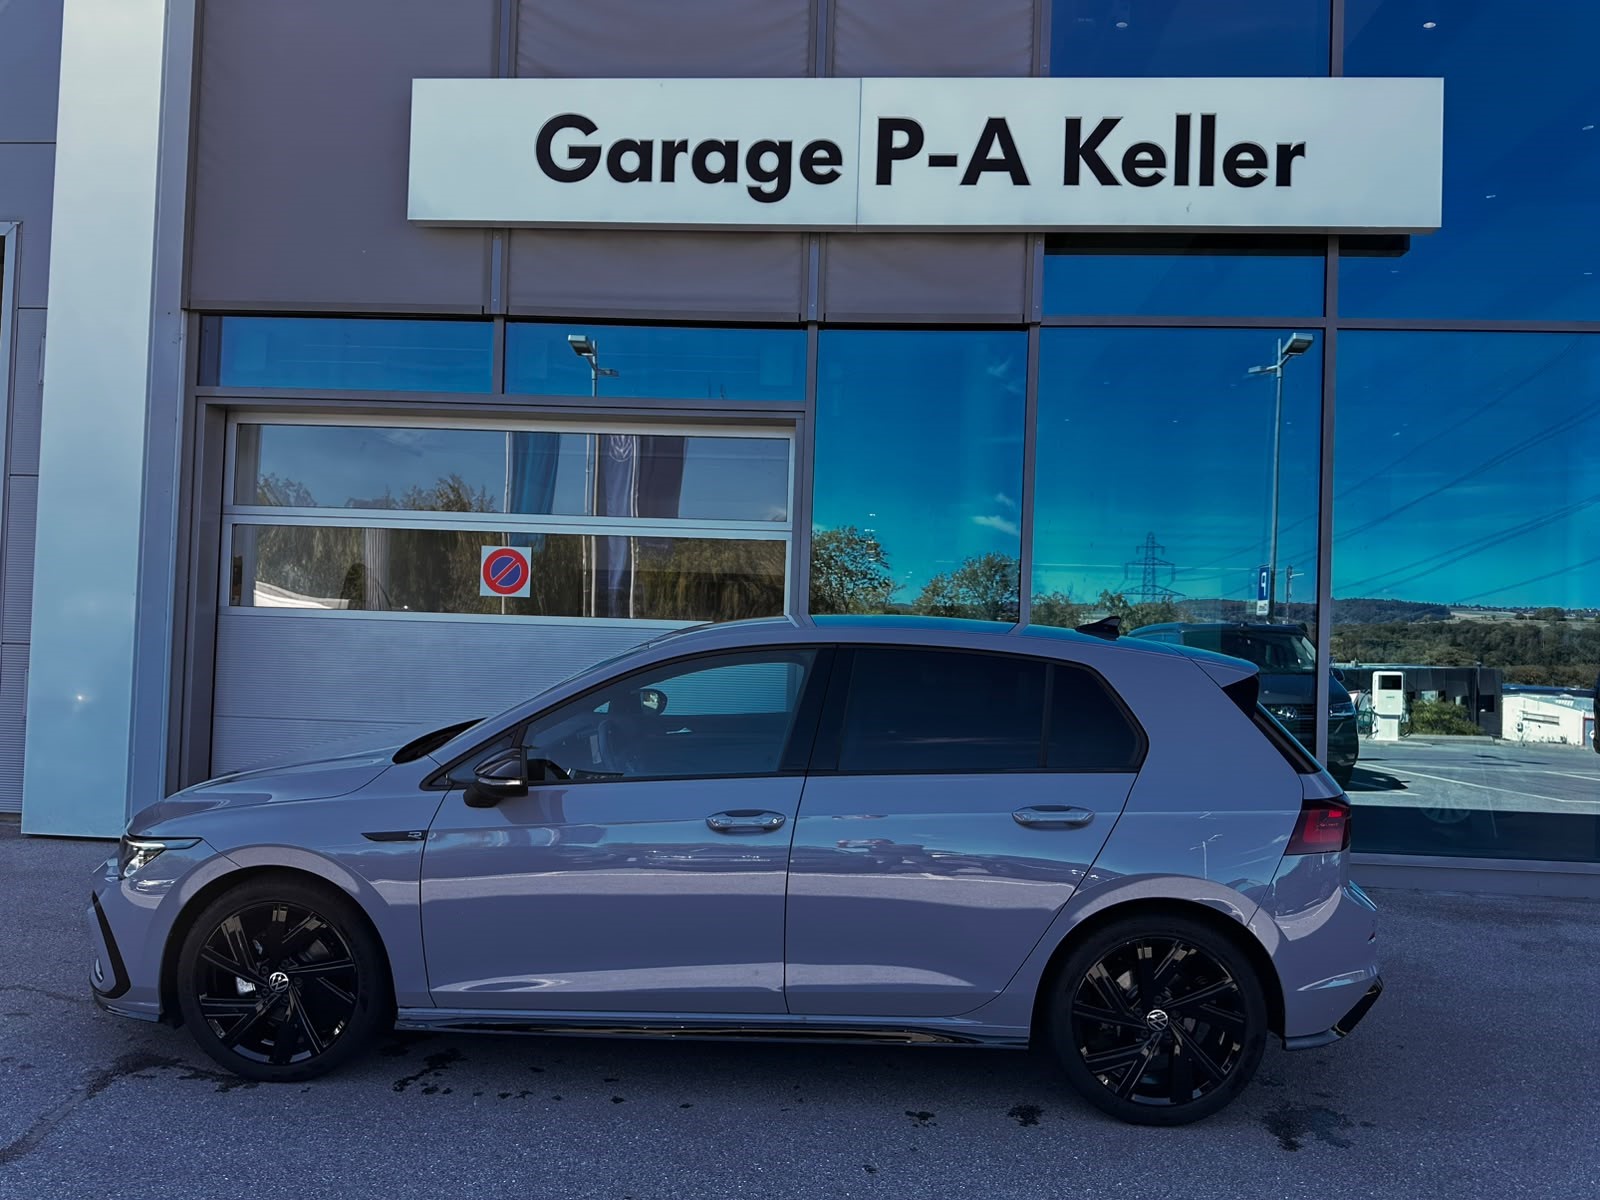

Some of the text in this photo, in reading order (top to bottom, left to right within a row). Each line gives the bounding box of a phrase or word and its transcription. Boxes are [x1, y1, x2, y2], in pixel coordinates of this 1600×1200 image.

[535, 112, 1306, 204] Garage P-A Keller
